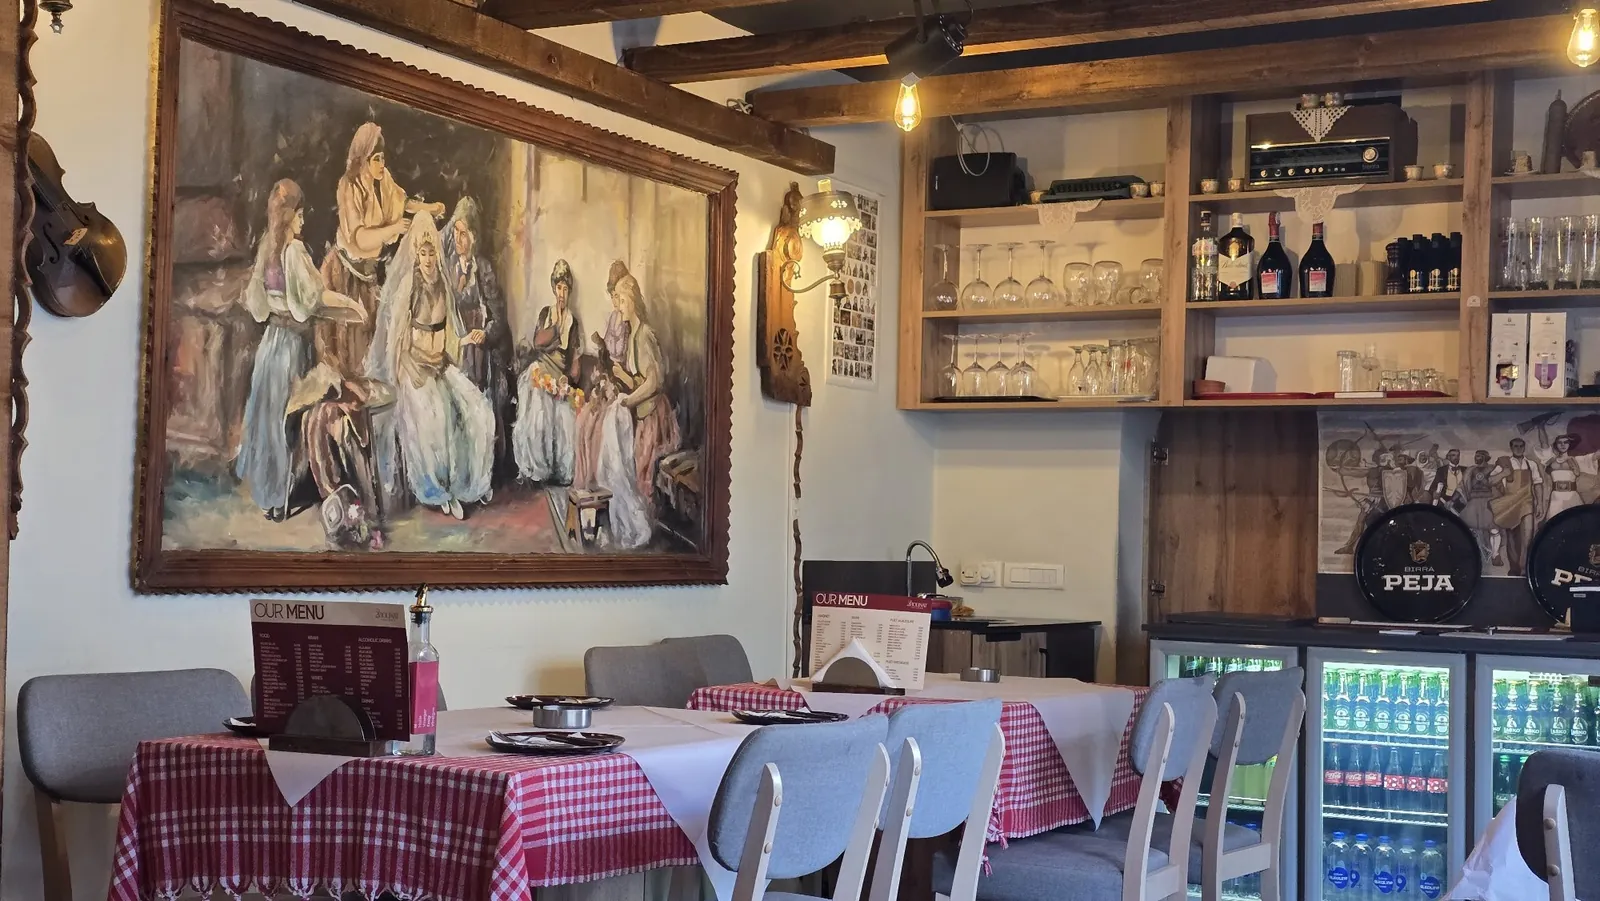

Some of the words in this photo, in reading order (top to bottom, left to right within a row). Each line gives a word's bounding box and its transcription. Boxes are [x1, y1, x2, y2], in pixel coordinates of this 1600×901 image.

[1383, 574, 1455, 592] PEJA
[816, 593, 837, 605] OUR
[838, 594, 869, 607] MENU
[254, 602, 284, 619] OUR
[286, 603, 325, 620] MENU
